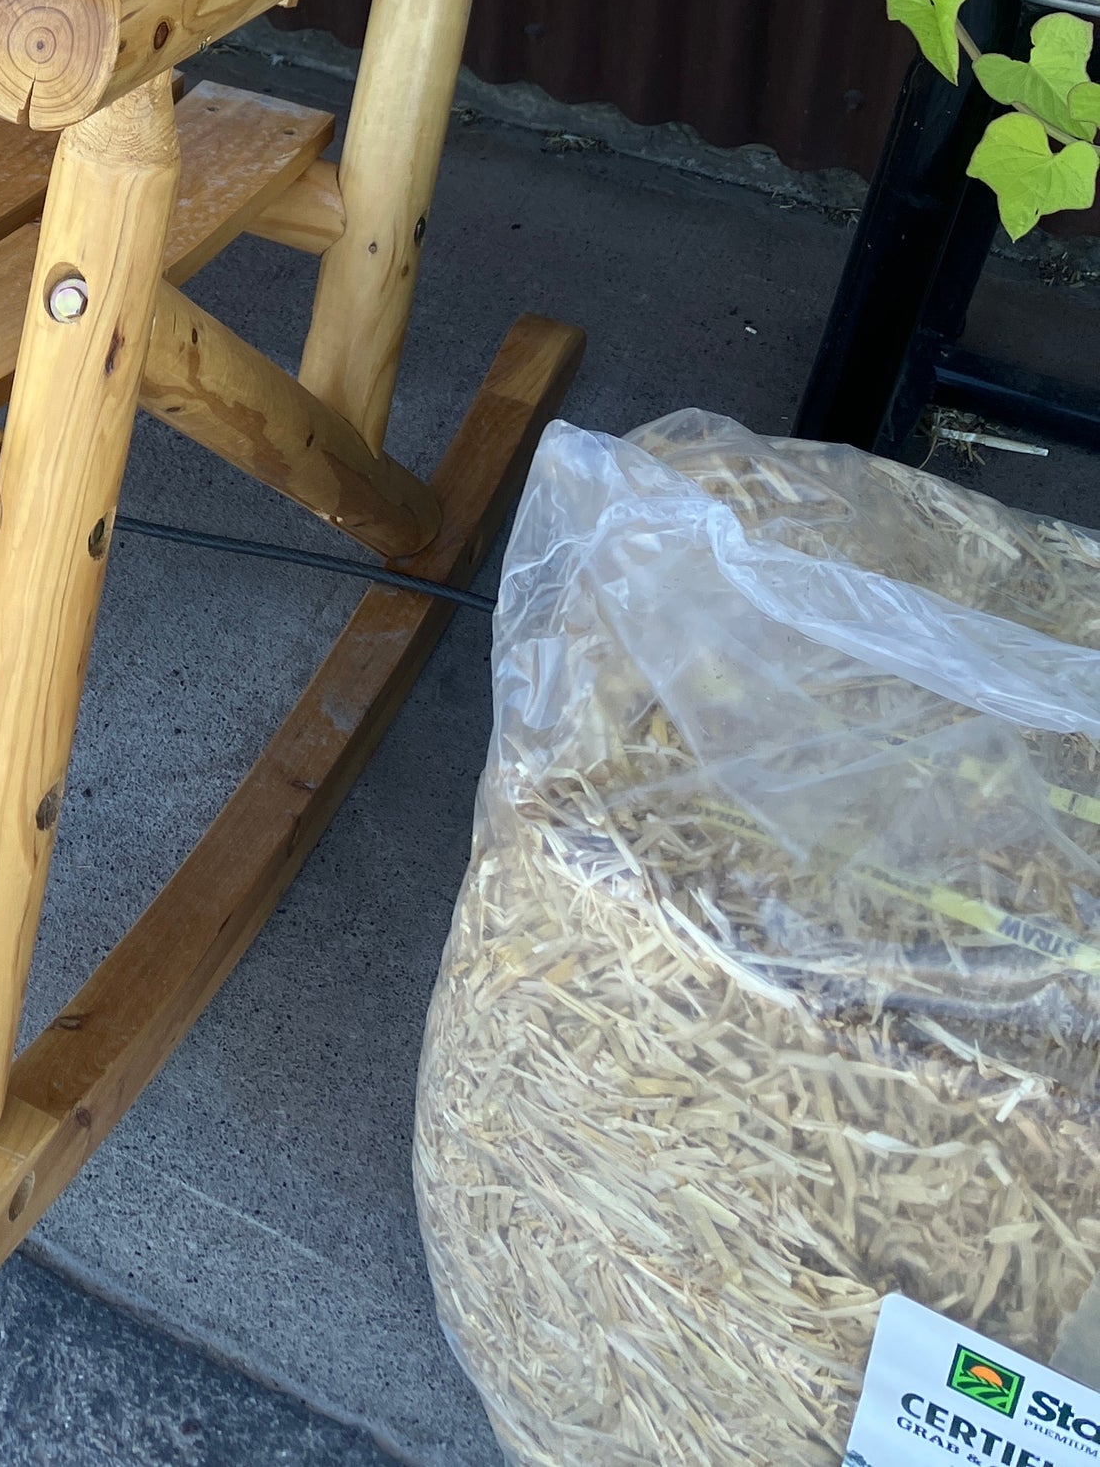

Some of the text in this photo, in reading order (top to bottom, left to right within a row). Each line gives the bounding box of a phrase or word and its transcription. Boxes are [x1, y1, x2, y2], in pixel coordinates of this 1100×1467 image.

[896, 1416, 982, 1466] GRAB &
[901, 1392, 1055, 1467] CERTIF
[1022, 1418, 1099, 1458] PREMIUM
